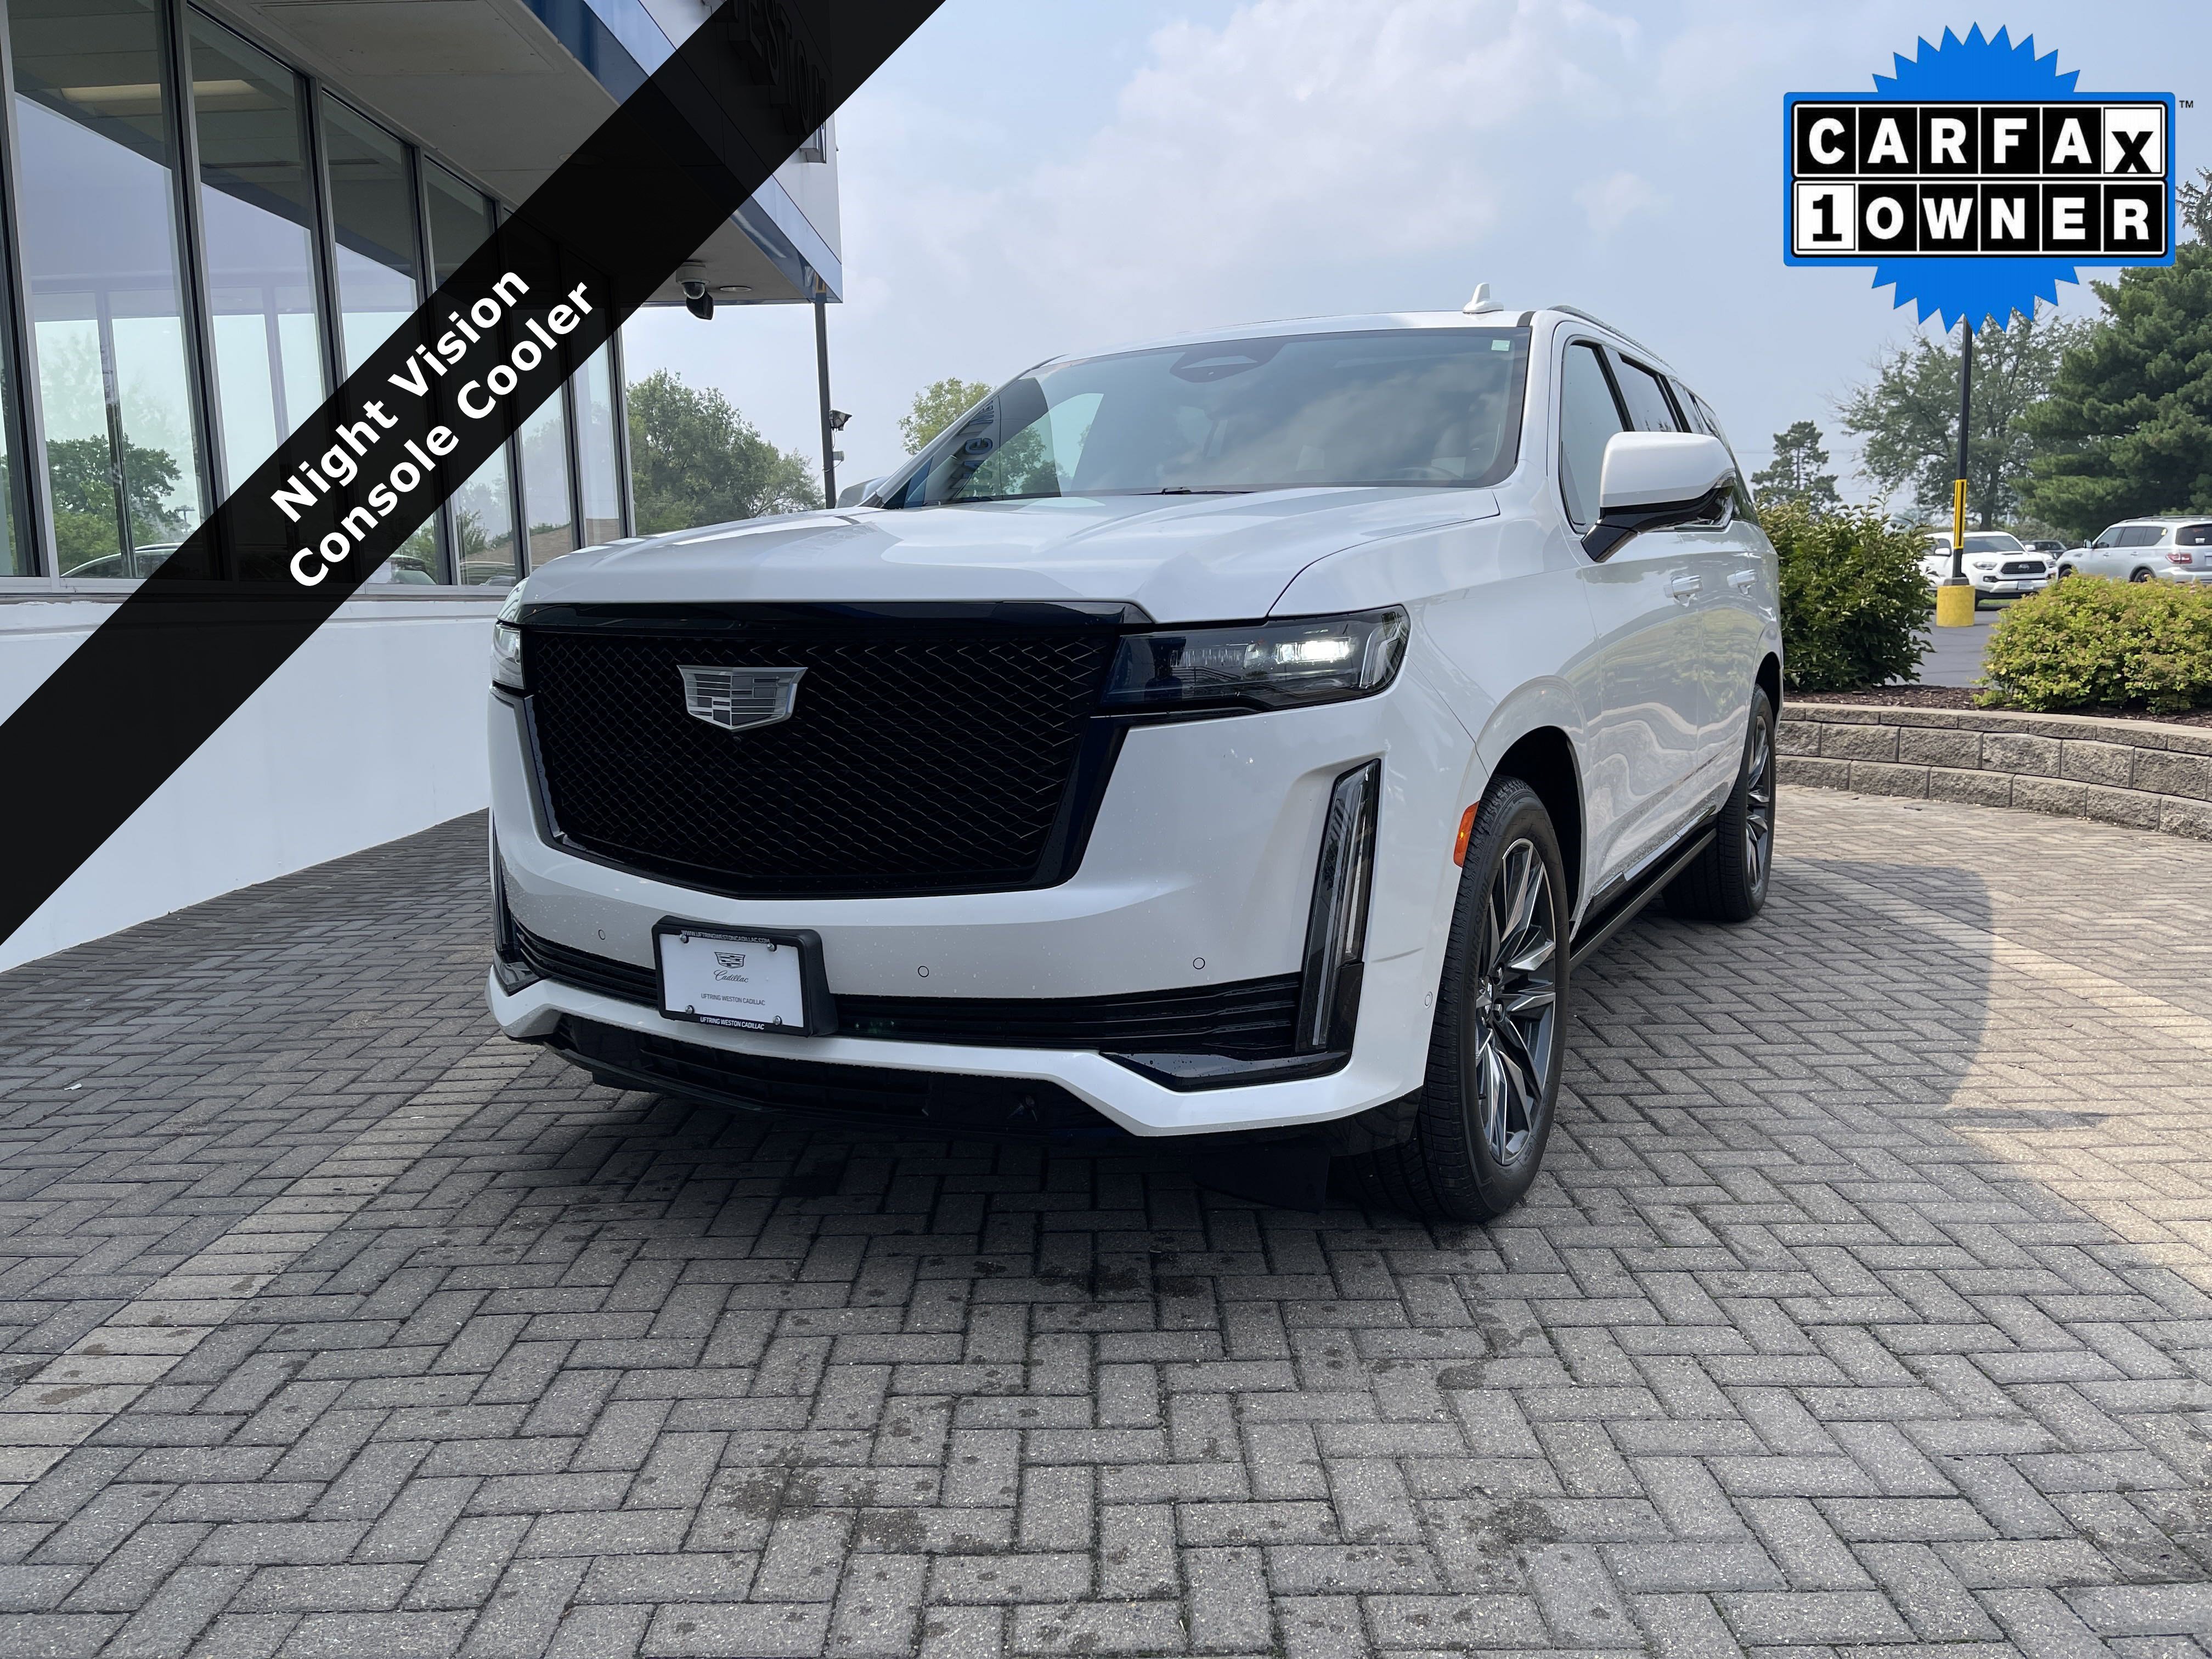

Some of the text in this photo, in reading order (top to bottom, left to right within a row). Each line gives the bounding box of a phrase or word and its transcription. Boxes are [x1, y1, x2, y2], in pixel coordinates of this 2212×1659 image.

[713, 969, 749, 983] Cadillac
[743, 997, 765, 1006] CADILLAC
[720, 1019, 741, 1027] WESTON
[742, 1021, 765, 1030] CADILLAC
